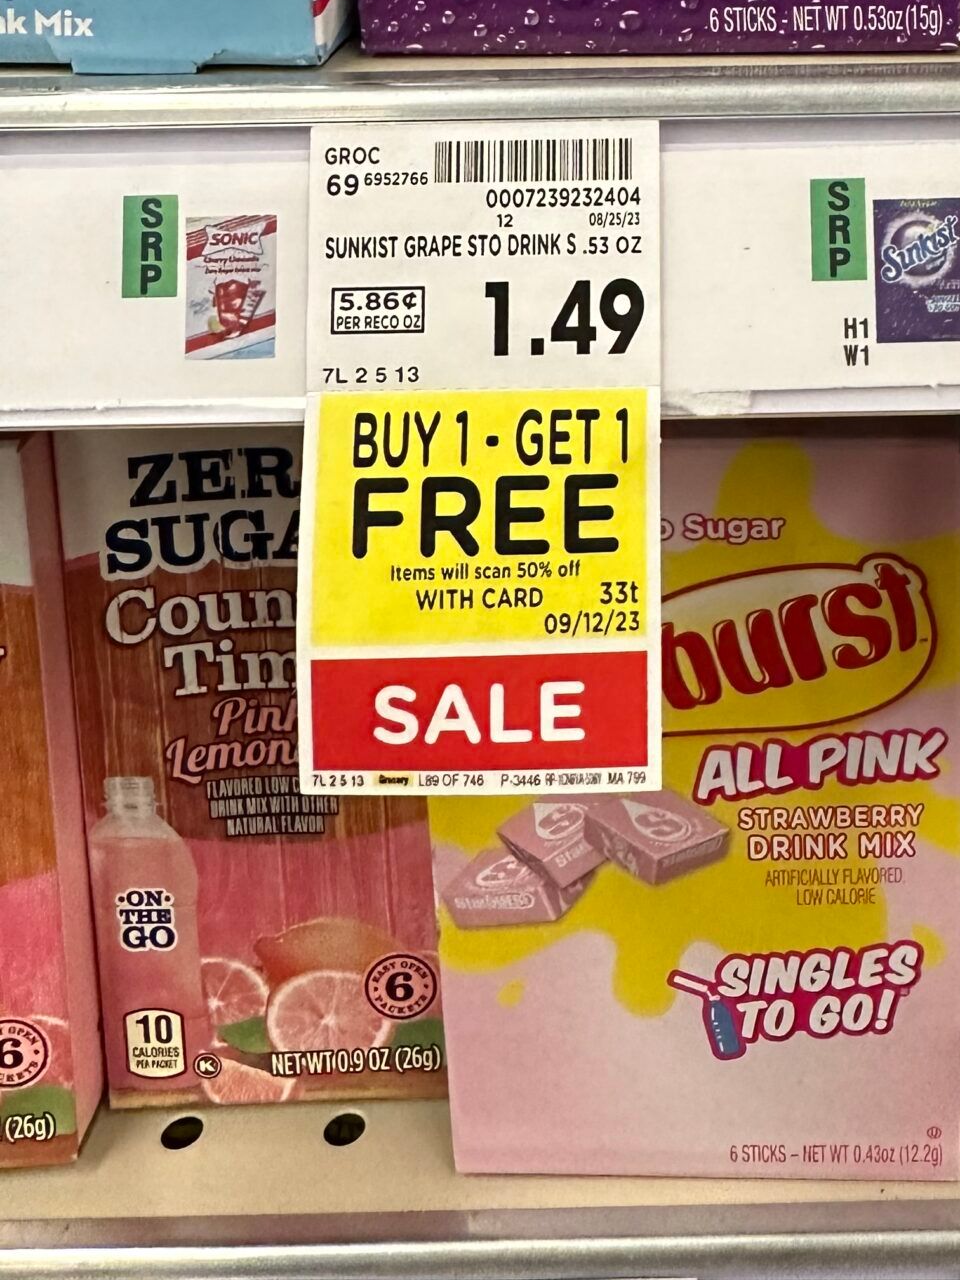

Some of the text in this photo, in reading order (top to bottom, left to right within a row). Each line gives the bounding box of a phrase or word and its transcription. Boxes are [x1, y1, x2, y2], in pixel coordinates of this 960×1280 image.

[325, 147, 380, 165] GROC
[326, 174, 359, 196] 69
[364, 172, 428, 186] 6952766
[486, 187, 640, 208] 0007239232404
[589, 212, 640, 226] 08/25/23
[828, 181, 851, 278] SRP
[140, 198, 163, 295] SRP
[325, 232, 642, 259] SUNKIST GRAPE STO DRINK S .53 OZ
[339, 292, 417, 311] 5.86¢
[336, 314, 421, 330] PER RECO OZ
[484, 278, 645, 356] 1.49
[844, 318, 869, 338] H1
[843, 345, 869, 366] W1
[352, 410, 441, 468] BUY
[456, 410, 469, 466] 1
[515, 408, 600, 465] GET
[616, 407, 628, 464] 1
[352, 473, 619, 559] FREE
[684, 513, 785, 541] Sugar
[390, 559, 581, 582] Items will scan 50% off
[416, 587, 543, 610] WITH CARD
[599, 582, 639, 605] 33t
[544, 610, 640, 637] 09/12/23
[373, 680, 586, 745] SALE
[694, 728, 948, 805] ALL PINK
[738, 803, 923, 831] STRAWBERRY
[747, 832, 916, 862] DRINK MIX
[119, 909, 171, 924] THE
[122, 926, 176, 948] GO
[715, 943, 921, 999] SINGLES
[736, 989, 896, 1040] TO GO!
[135, 1014, 173, 1043] 10
[272, 1048, 441, 1075] NET WT 0.9 OZ (26g)
